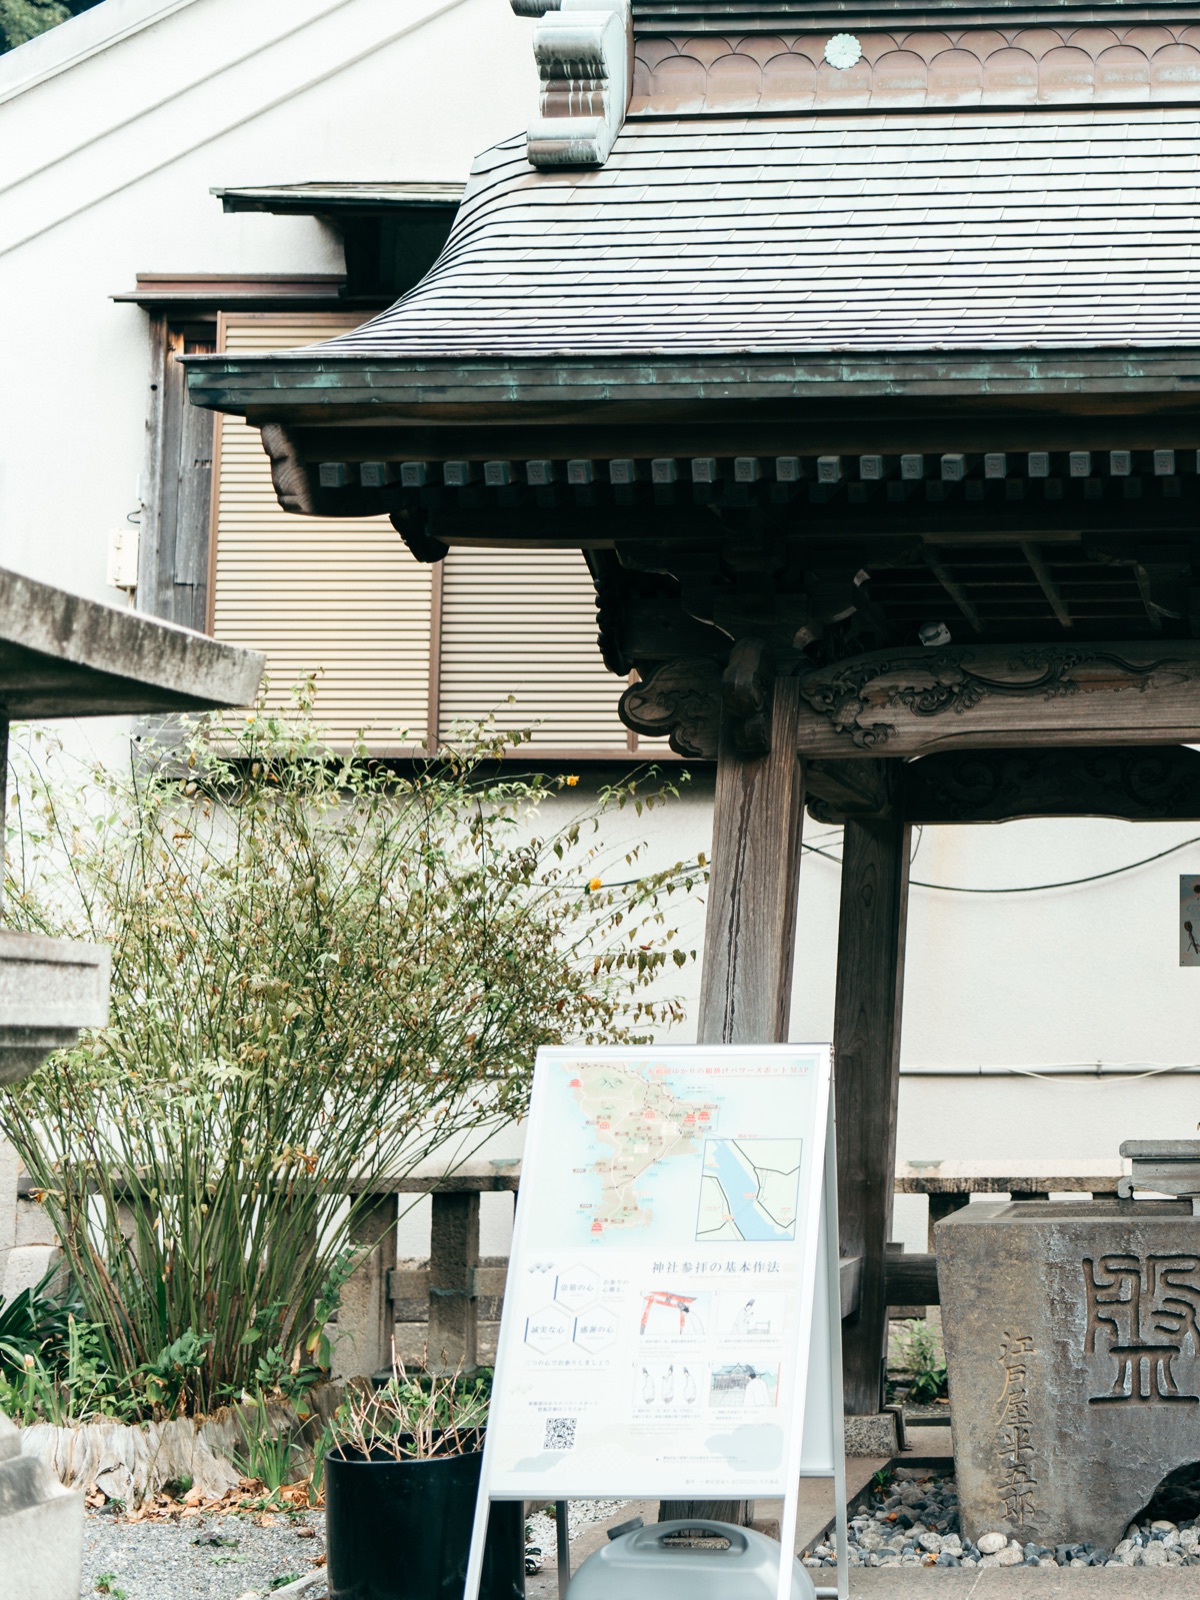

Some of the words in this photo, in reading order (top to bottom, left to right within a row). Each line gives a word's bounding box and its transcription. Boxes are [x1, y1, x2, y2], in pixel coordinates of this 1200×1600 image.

[652, 1261, 780, 1274] 神社参拝の基本作法
[531, 1325, 565, 1334] 誠実な心
[580, 1325, 614, 1334] 感謝の心
[995, 1331, 1037, 1524] 江戸屋半五郎
